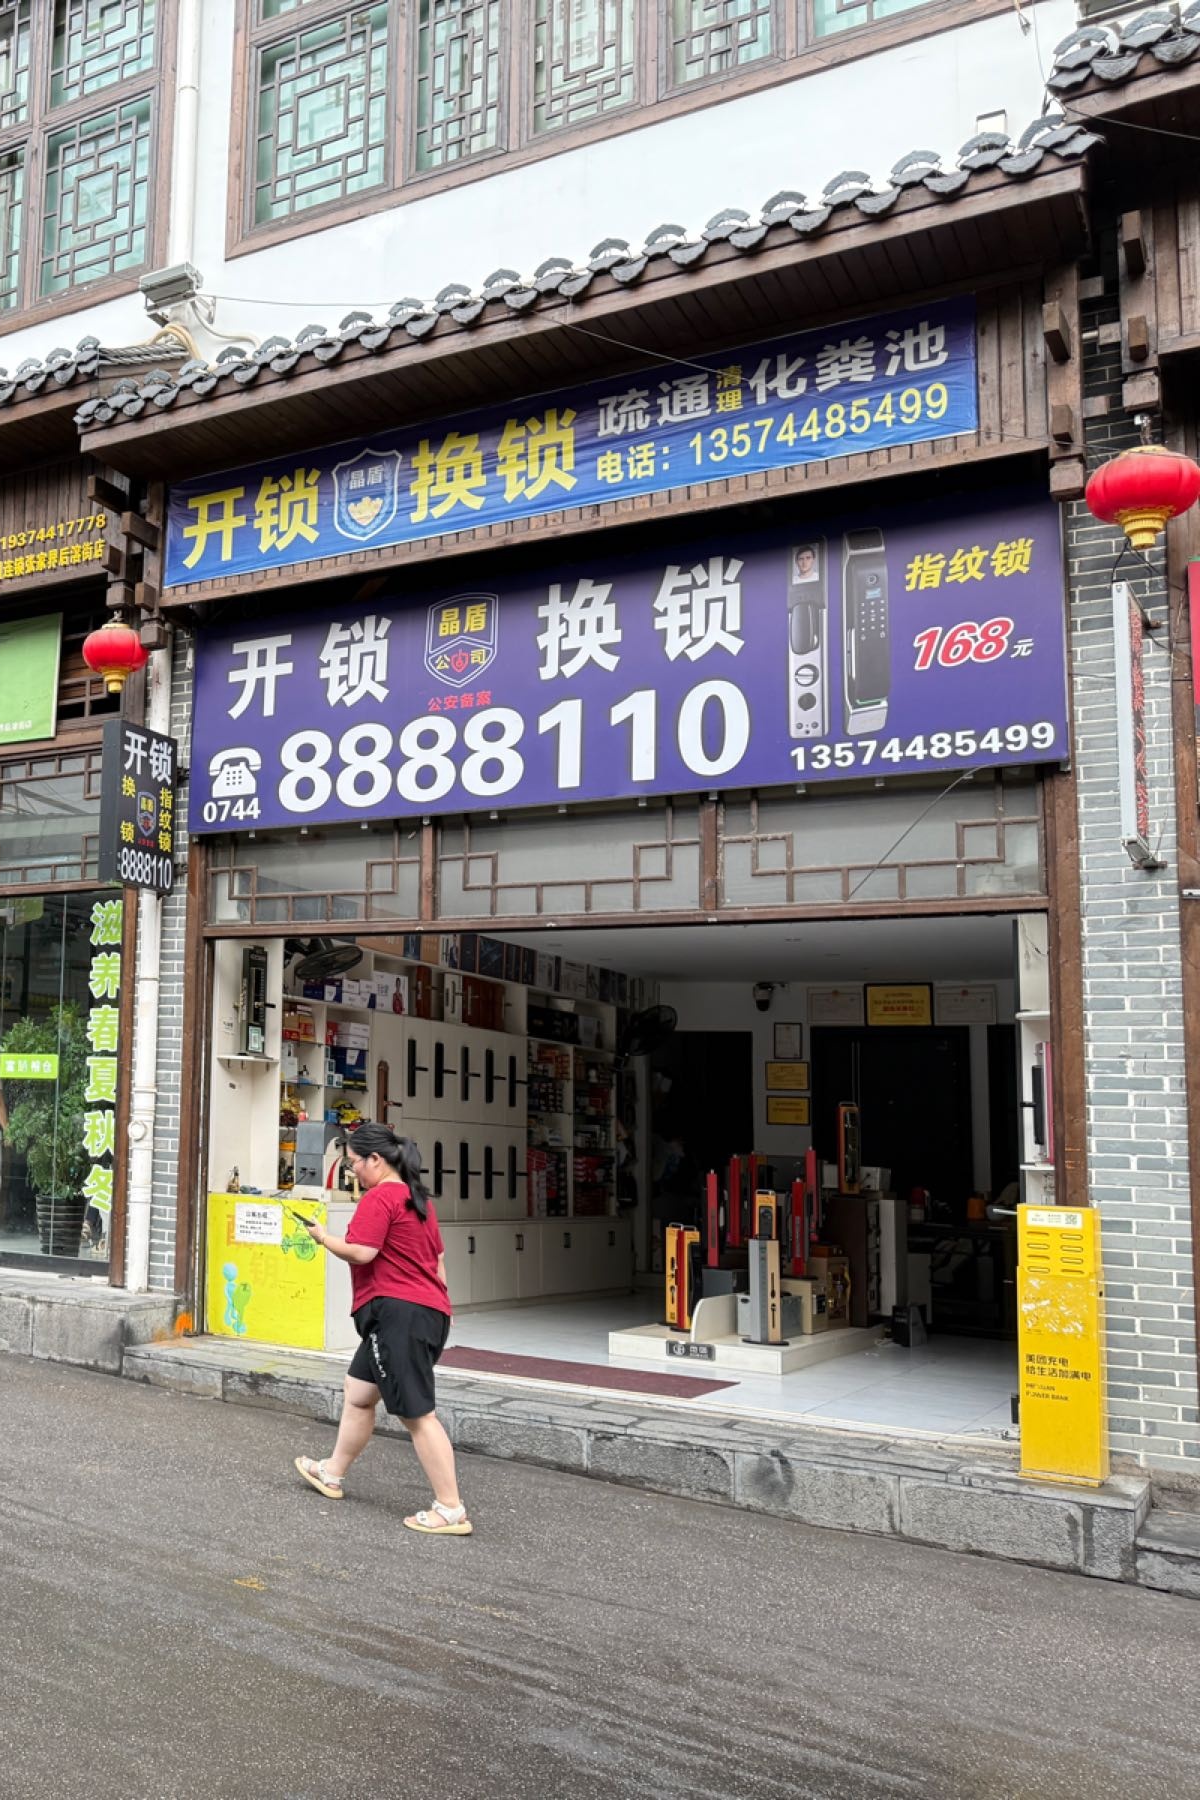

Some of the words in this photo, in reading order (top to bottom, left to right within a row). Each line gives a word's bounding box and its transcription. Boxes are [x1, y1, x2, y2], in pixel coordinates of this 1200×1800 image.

[597, 373, 712, 436] 疏通
[716, 365, 742, 415] 清理
[748, 321, 949, 406] 化粪池
[689, 383, 949, 469] 13574485499
[183, 467, 320, 570] 开锁
[409, 407, 578, 526] 换锁
[349, 465, 385, 490] 晶盾
[0, 513, 106, 550] 19374417778
[904, 536, 1035, 592] 指纹锁
[228, 614, 393, 721] 开锁
[537, 556, 746, 682] 换锁
[438, 602, 488, 637] 晶盾
[913, 617, 1014, 671] 168
[1011, 637, 1034, 658] 元
[428, 690, 493, 712] 公安备案
[123, 729, 173, 786] 开锁
[278, 680, 751, 814] 8888110
[790, 721, 1055, 772] 13574485499
[120, 774, 136, 844] 换锁
[158, 787, 173, 853] 指纹锁
[203, 796, 262, 824] 0744
[120, 846, 173, 890] 8888110
[82, 900, 123, 1212] 滋养春夏秋冬
[1025, 1353, 1069, 1367] 美团充电
[1025, 1365, 1092, 1381] 给生活加满电
